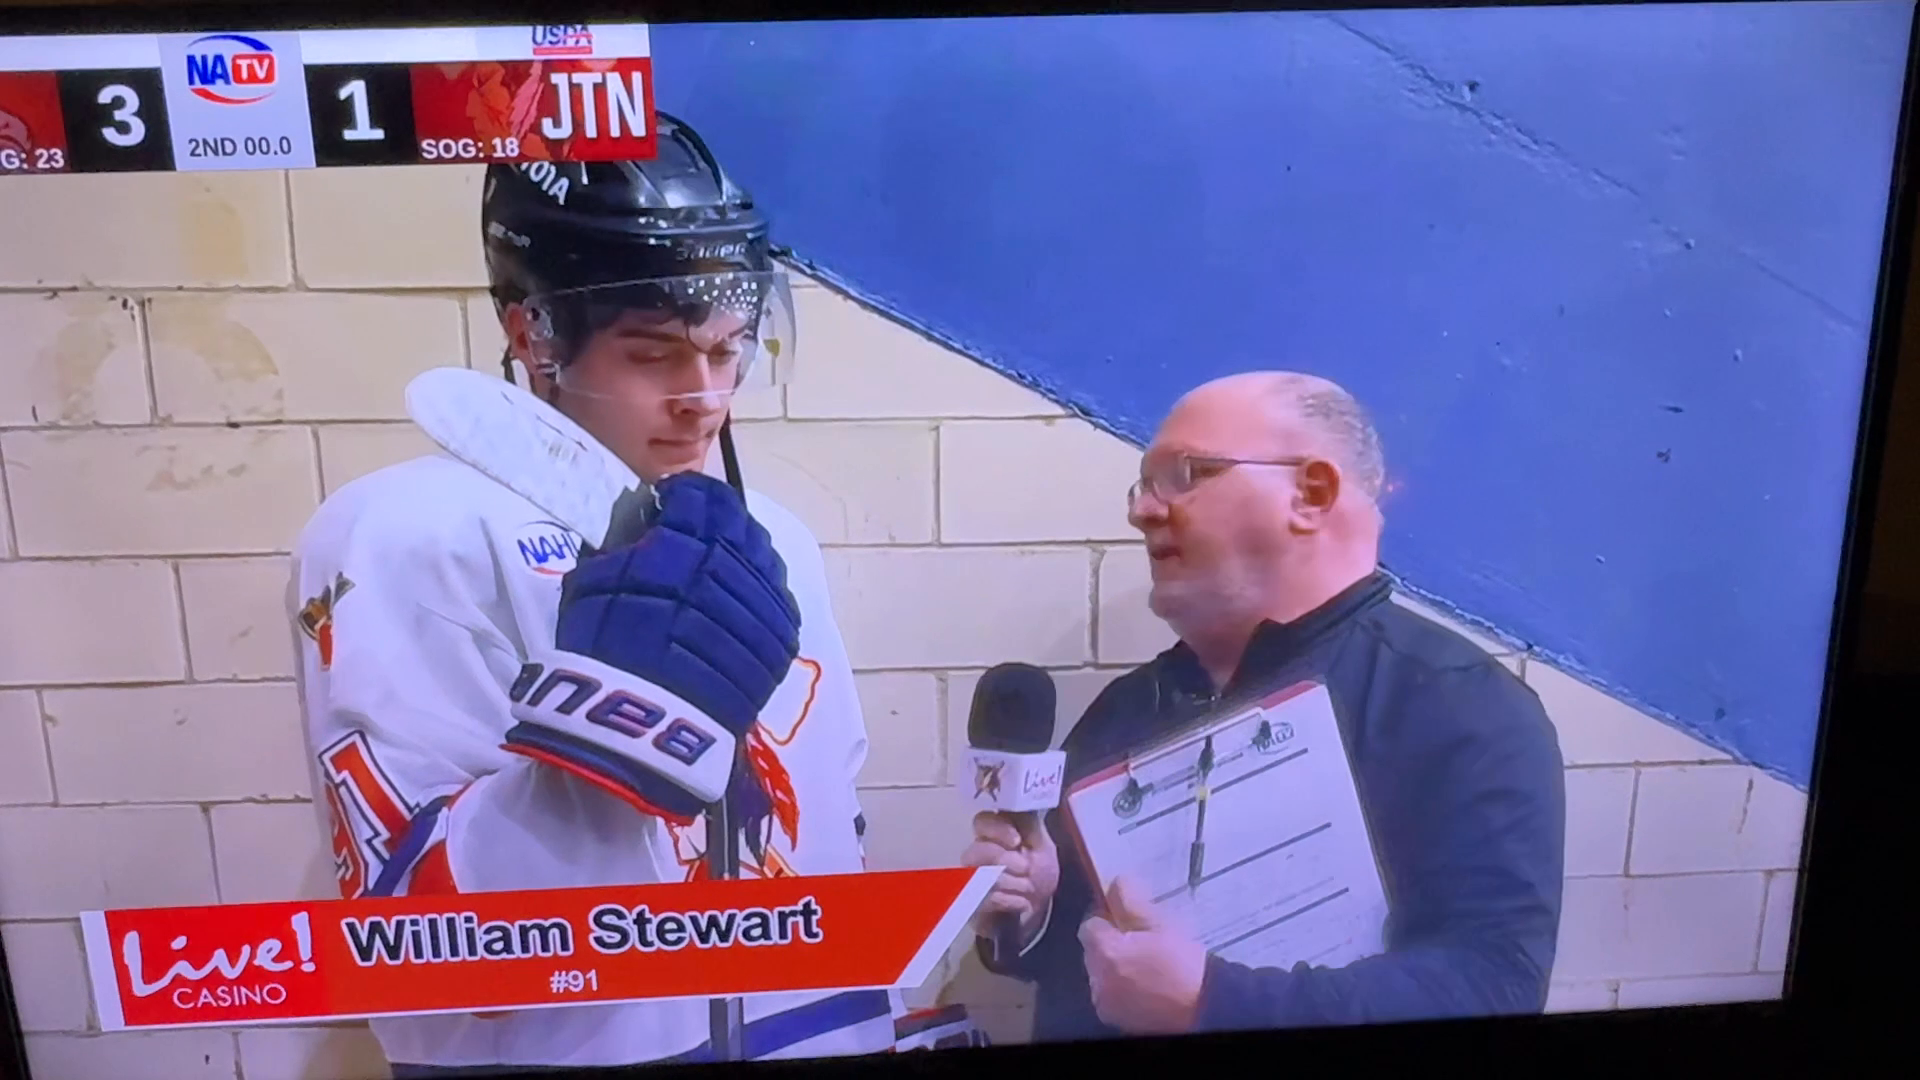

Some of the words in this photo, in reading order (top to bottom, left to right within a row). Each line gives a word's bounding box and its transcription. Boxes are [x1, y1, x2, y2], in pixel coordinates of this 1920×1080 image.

[97, 83, 146, 147] 3
[338, 79, 386, 141] 1
[541, 71, 647, 140] JTN
[34, 147, 65, 169] 23
[188, 137, 238, 157] 2ND
[244, 135, 292, 156] 00.0
[421, 138, 485, 159] SOG:
[491, 136, 520, 158] 18
[342, 912, 574, 967] William
[588, 896, 824, 955] Stewart
[122, 911, 316, 997] Live!
[172, 982, 287, 1009] CASINO
[549, 968, 599, 993] #91
